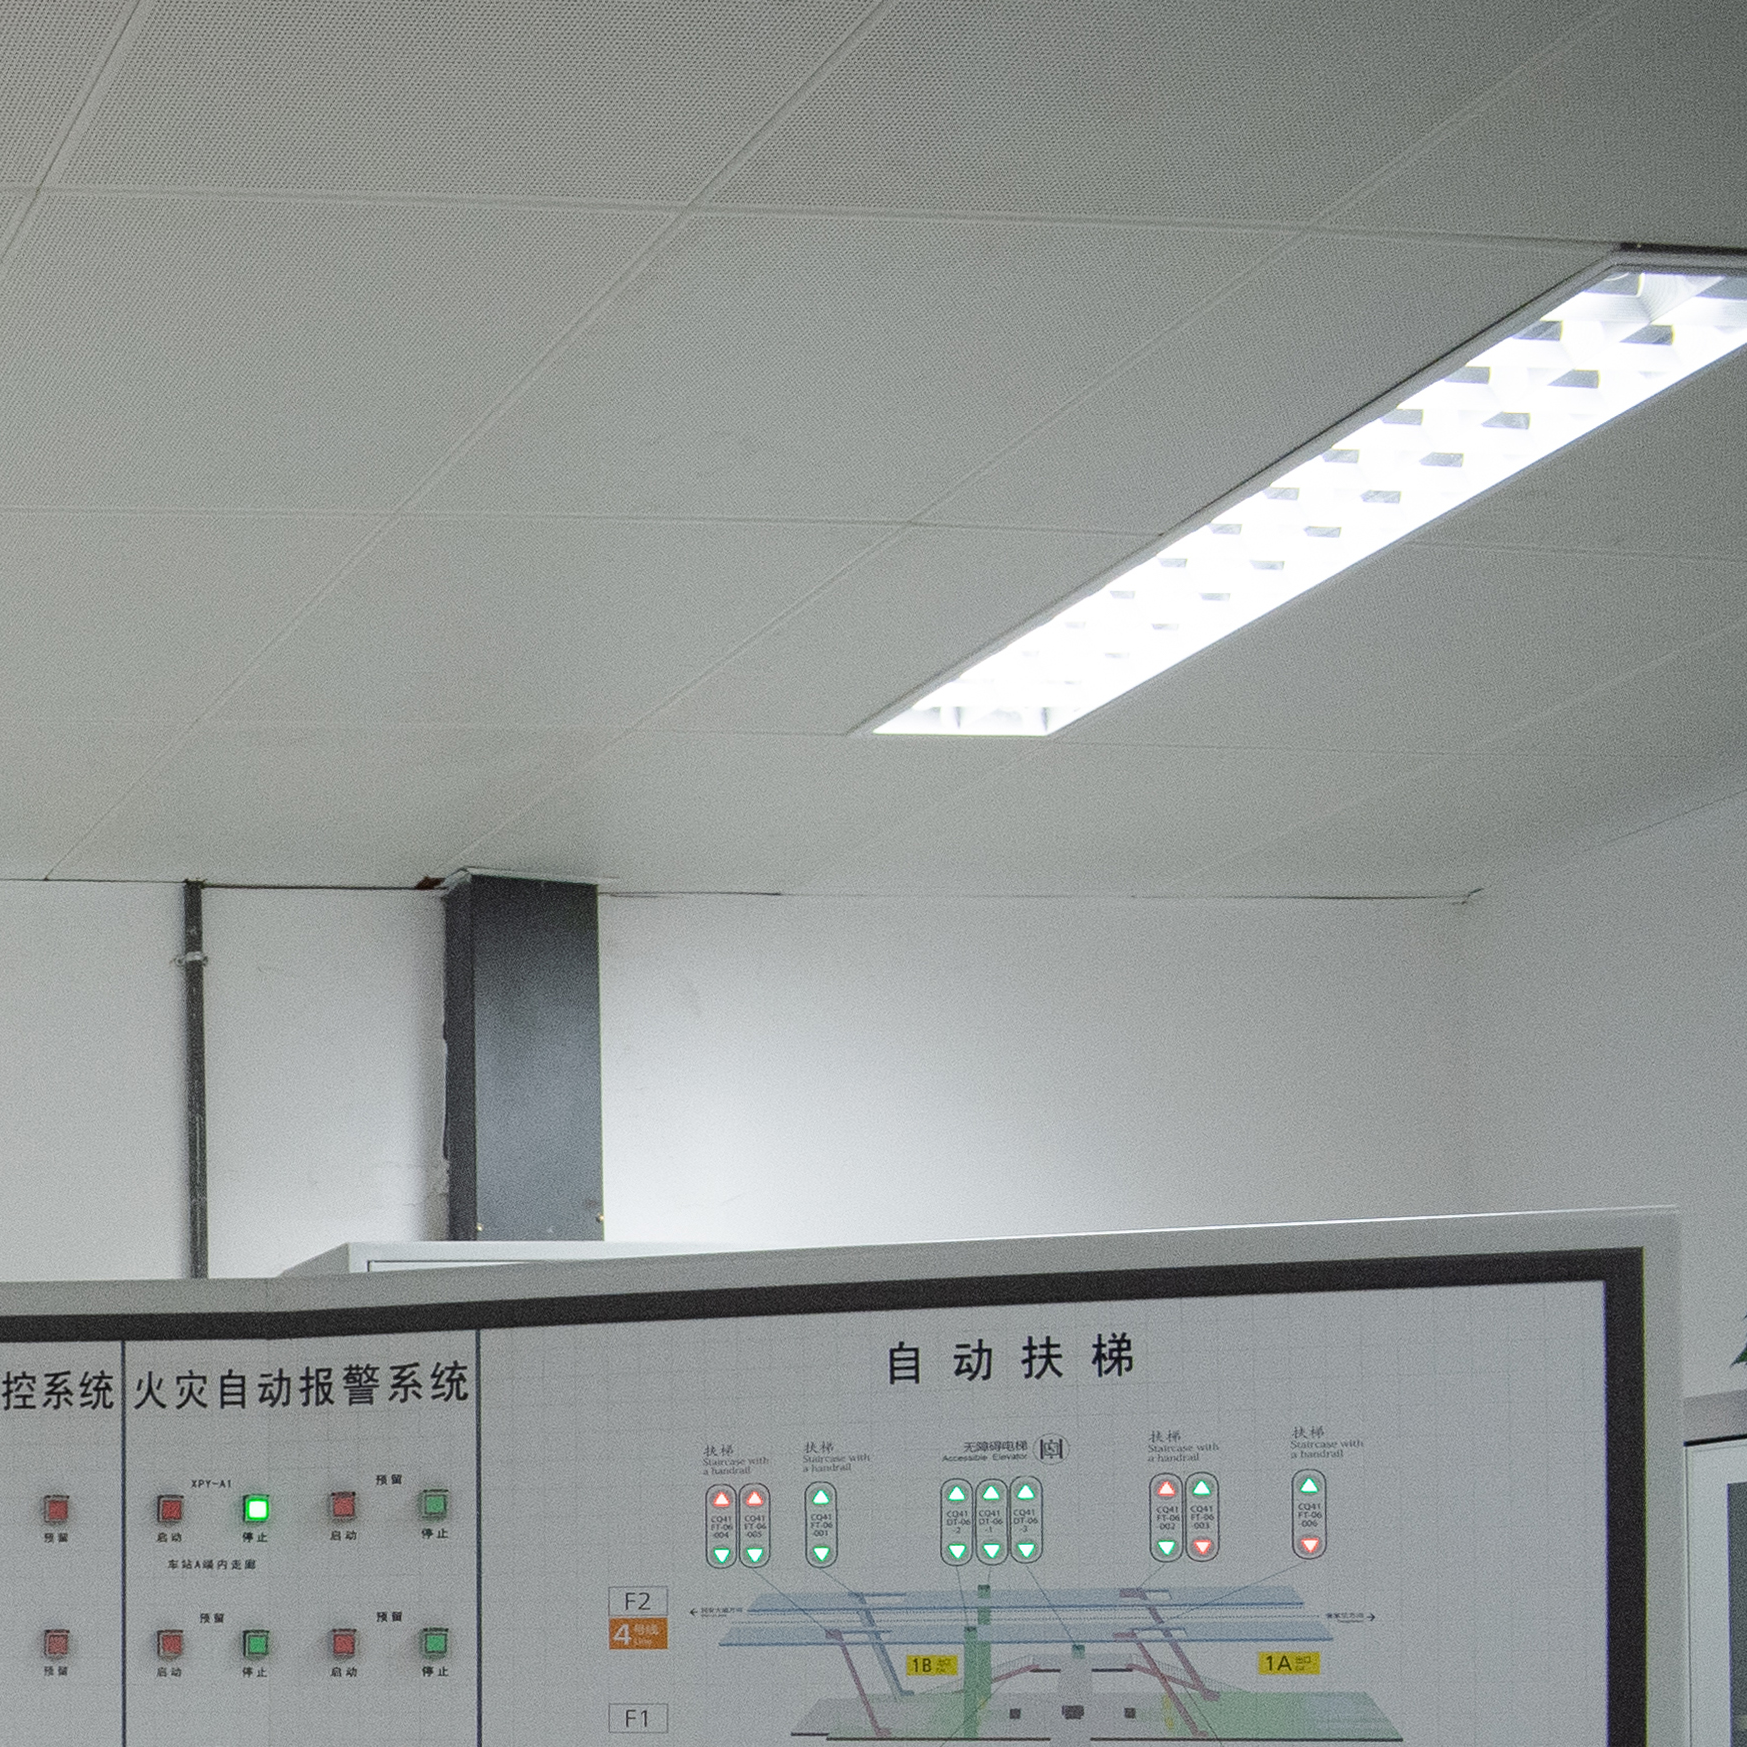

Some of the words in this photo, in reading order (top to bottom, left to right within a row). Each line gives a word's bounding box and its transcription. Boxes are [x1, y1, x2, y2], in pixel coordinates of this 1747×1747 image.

[887, 1332, 1136, 1385] 自动扶梯
[133, 1360, 469, 1410] 火灾自动报警系统
[626, 1592, 650, 1610] F2
[912, 1658, 932, 1673] 1B
[1266, 1656, 1292, 1671] 1A
[625, 1709, 649, 1728] F1
